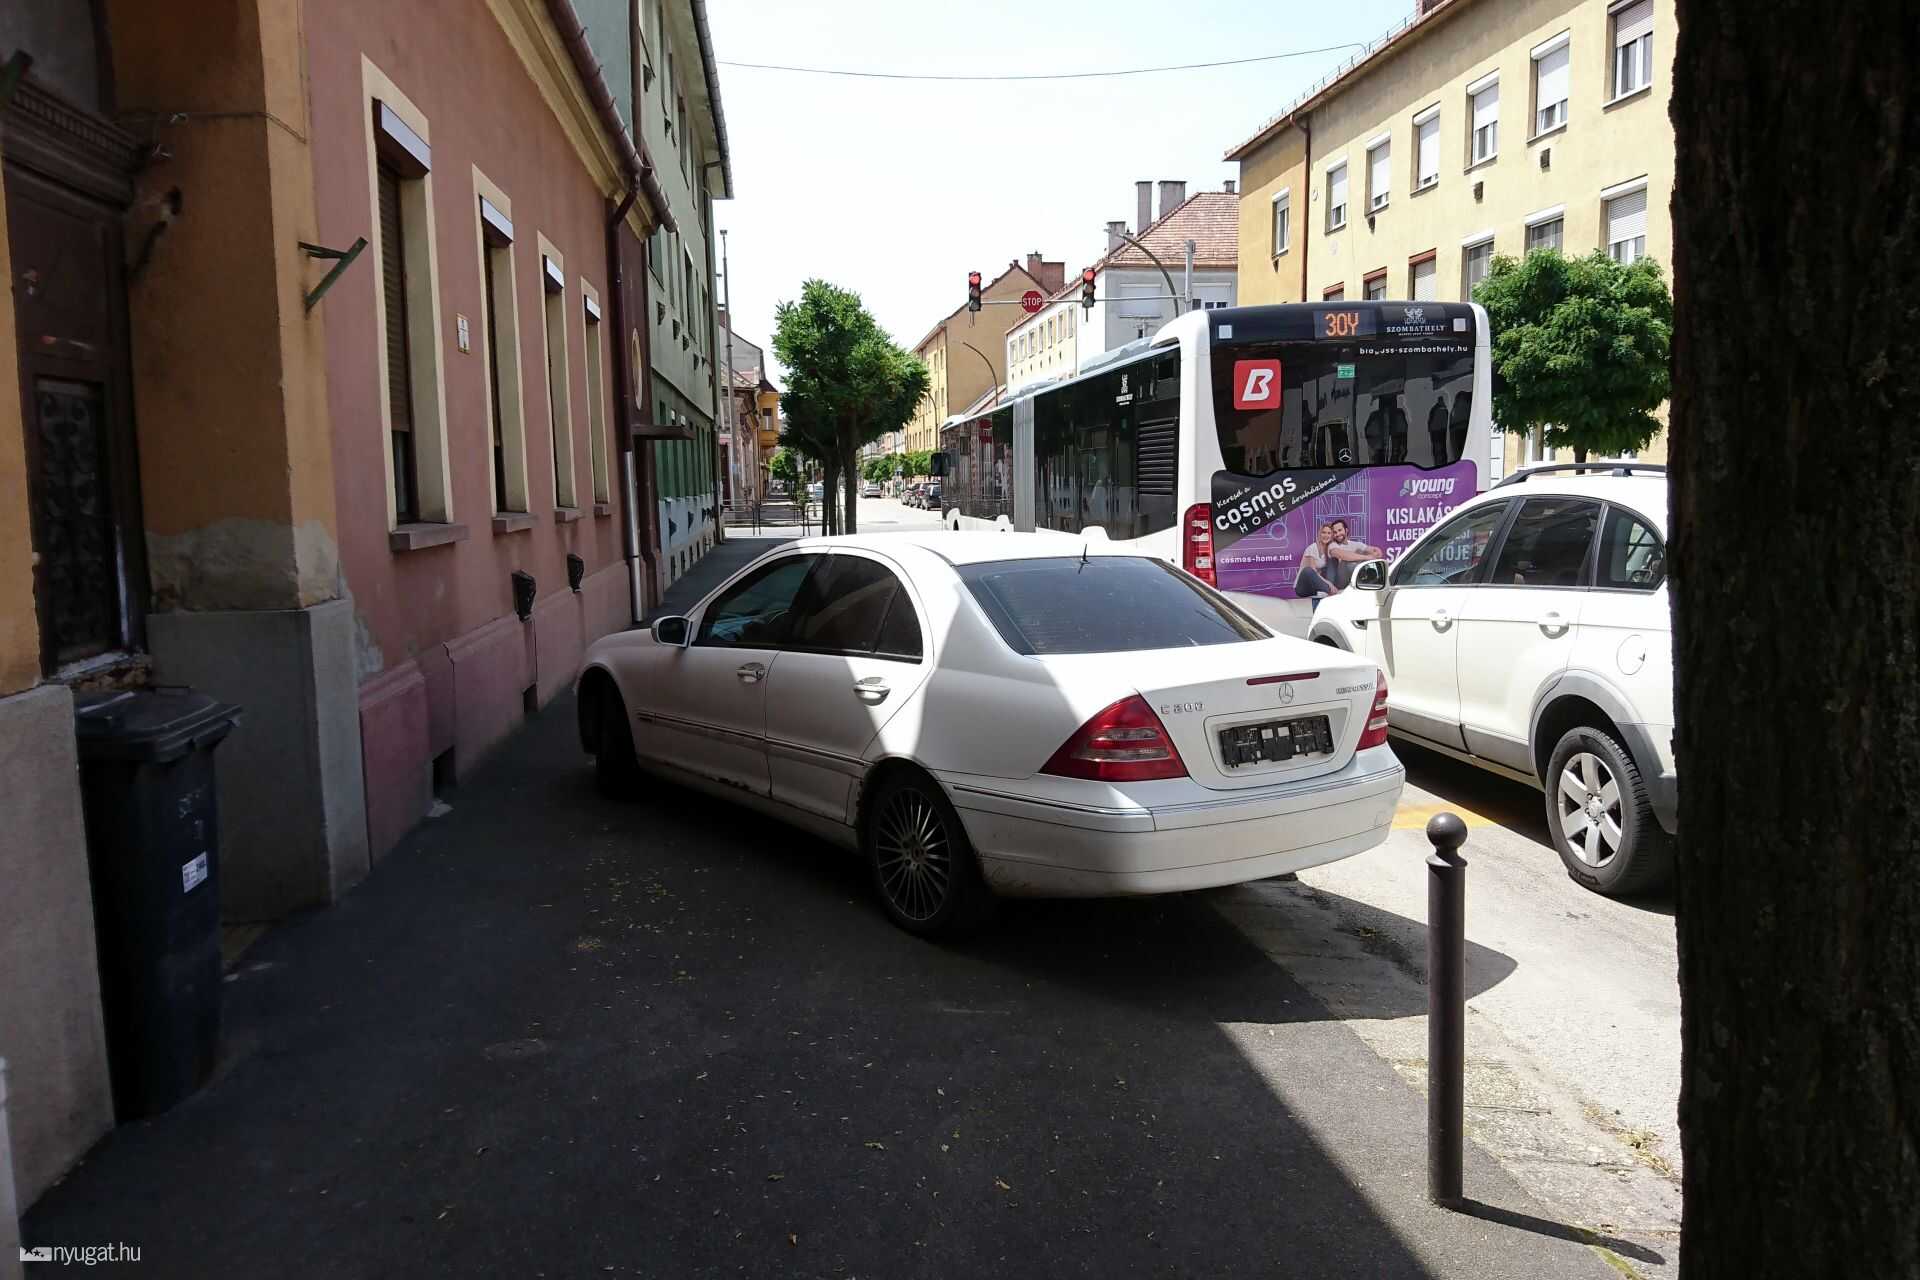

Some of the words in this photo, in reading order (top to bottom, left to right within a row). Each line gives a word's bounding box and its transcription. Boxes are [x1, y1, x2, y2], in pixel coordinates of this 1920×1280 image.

[1023, 297, 1042, 307] STOP
[1325, 312, 1359, 337] 30Y
[1386, 325, 1446, 333] SZOMBATHELY
[1241, 368, 1275, 401] B
[1410, 478, 1456, 496] young
[1215, 477, 1297, 531] cosmos
[1239, 501, 1287, 533] HOME
[1220, 552, 1293, 564] cosmos-home.net
